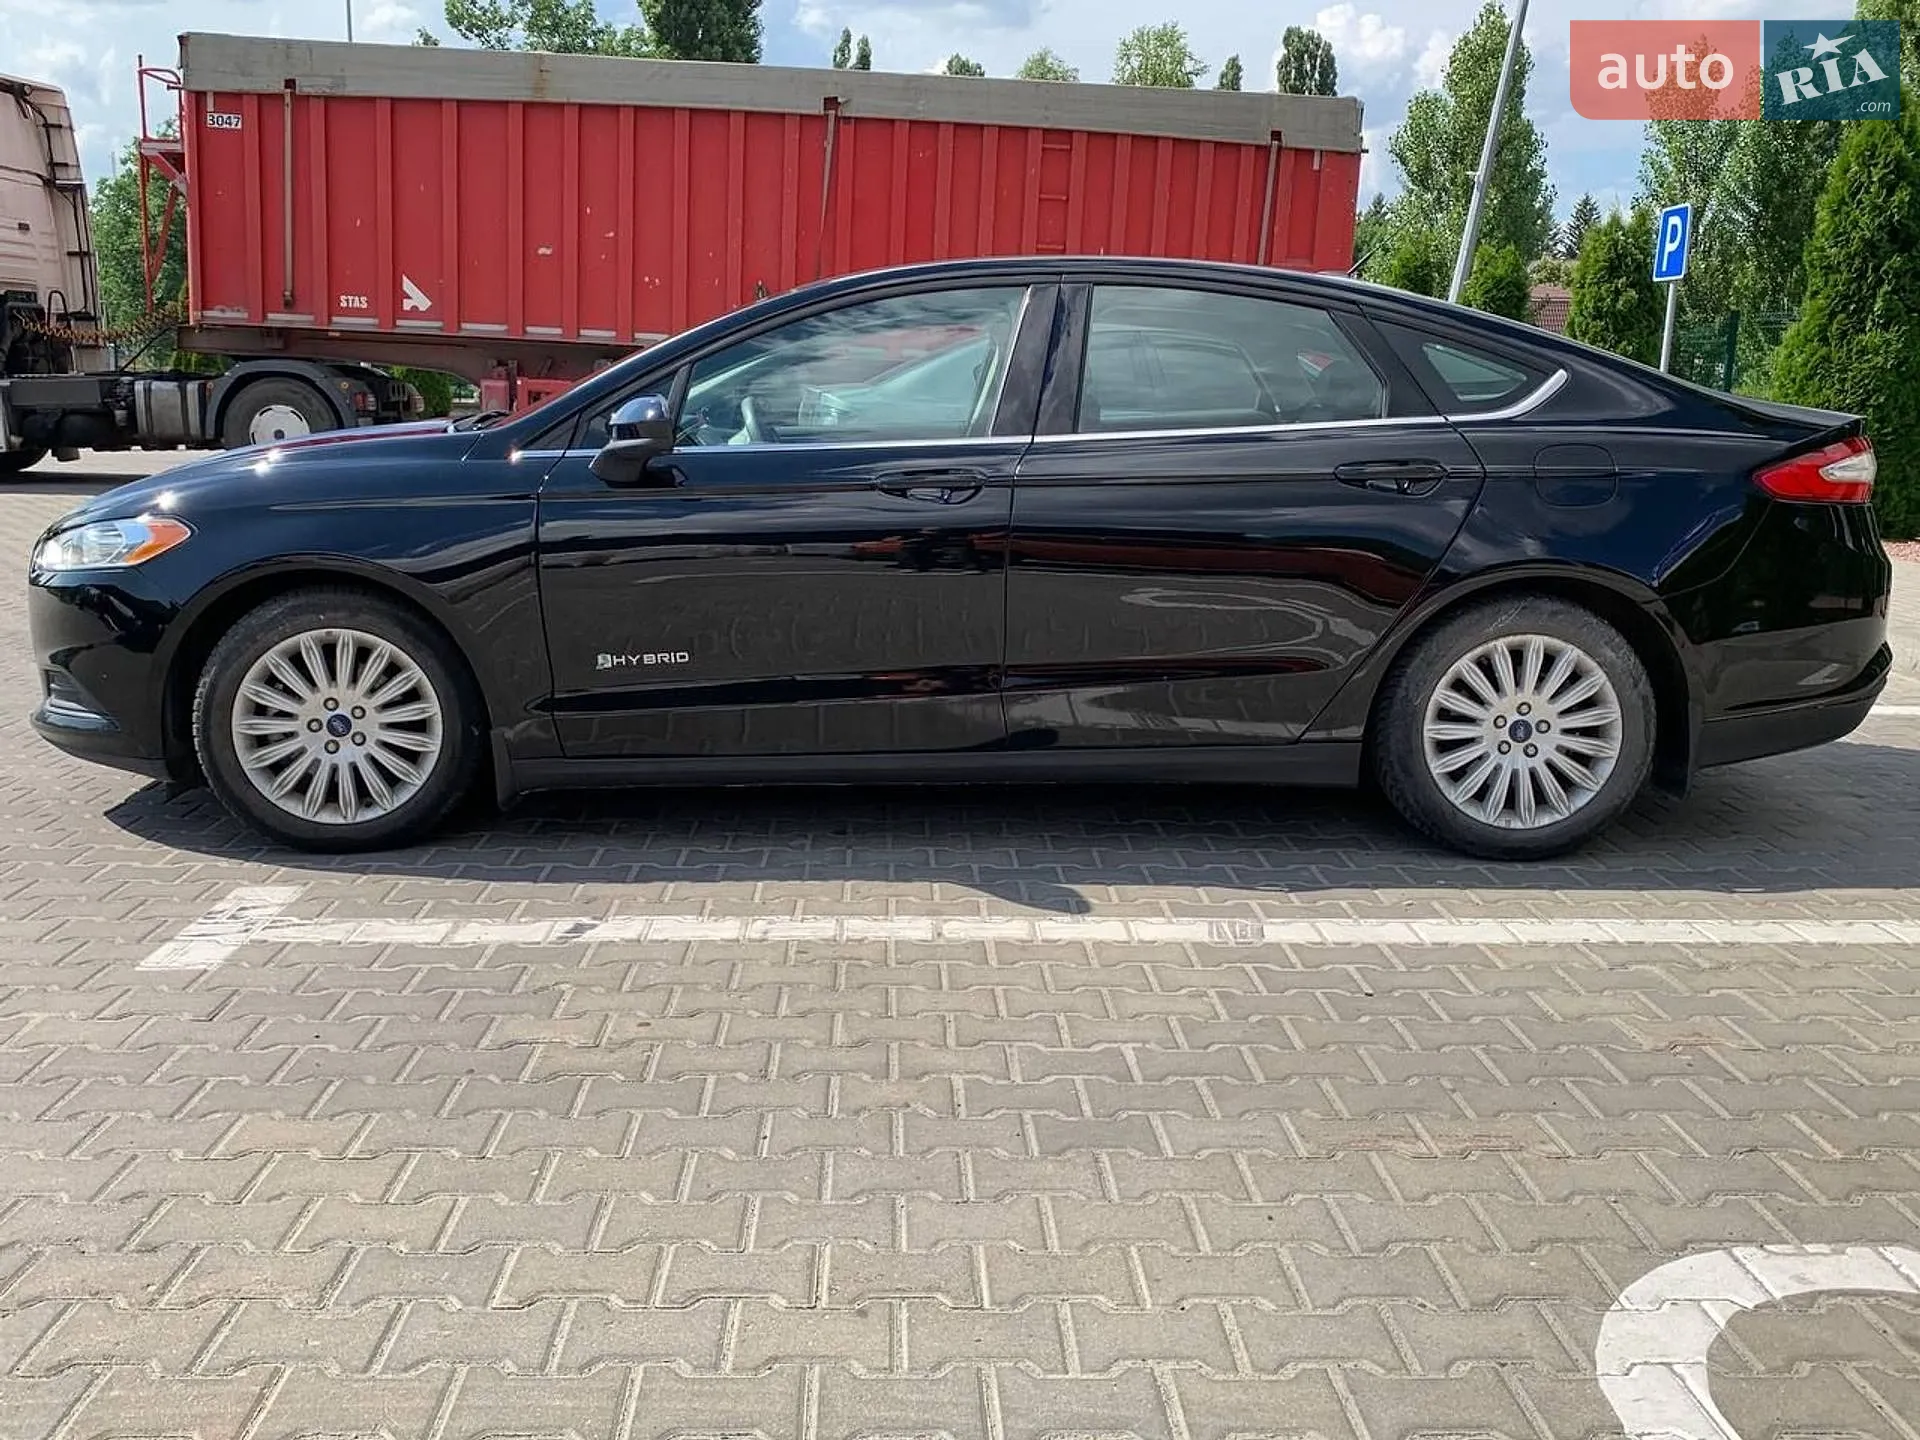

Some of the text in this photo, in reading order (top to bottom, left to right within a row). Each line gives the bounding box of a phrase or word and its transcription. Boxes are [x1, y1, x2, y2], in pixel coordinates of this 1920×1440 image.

[208, 114, 241, 127] 3047
[1661, 215, 1683, 272] P
[340, 295, 368, 309] STAS
[612, 651, 689, 666] HYBRID
